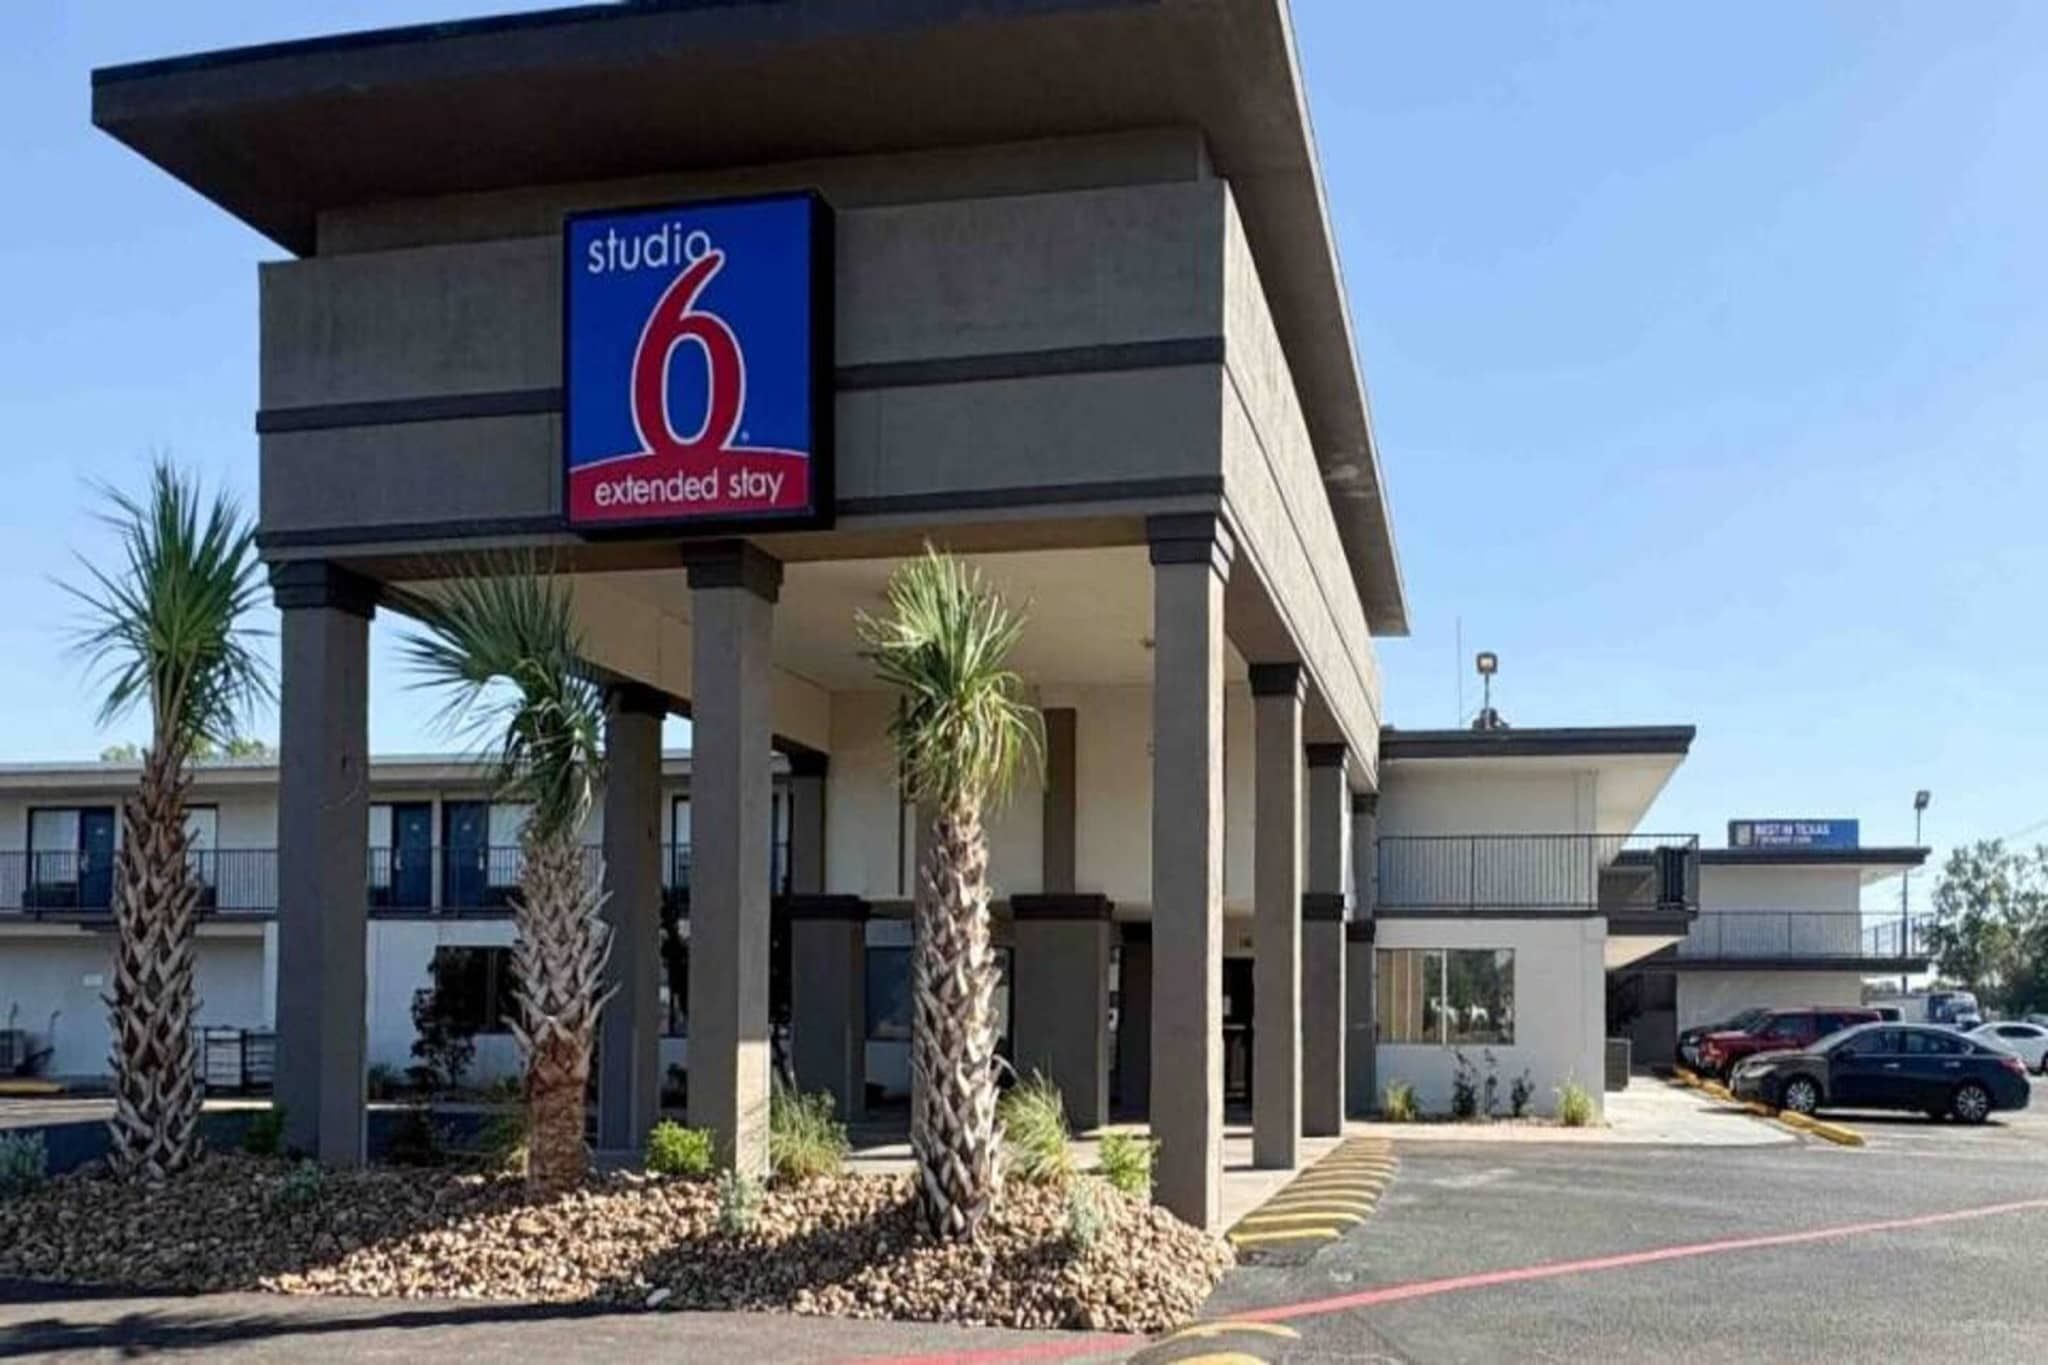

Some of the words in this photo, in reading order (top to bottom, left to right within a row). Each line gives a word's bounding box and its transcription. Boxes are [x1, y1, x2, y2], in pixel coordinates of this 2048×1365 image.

[587, 222, 711, 273] studio
[630, 249, 746, 454] 6
[594, 467, 718, 507] extended
[728, 468, 784, 504] stay
